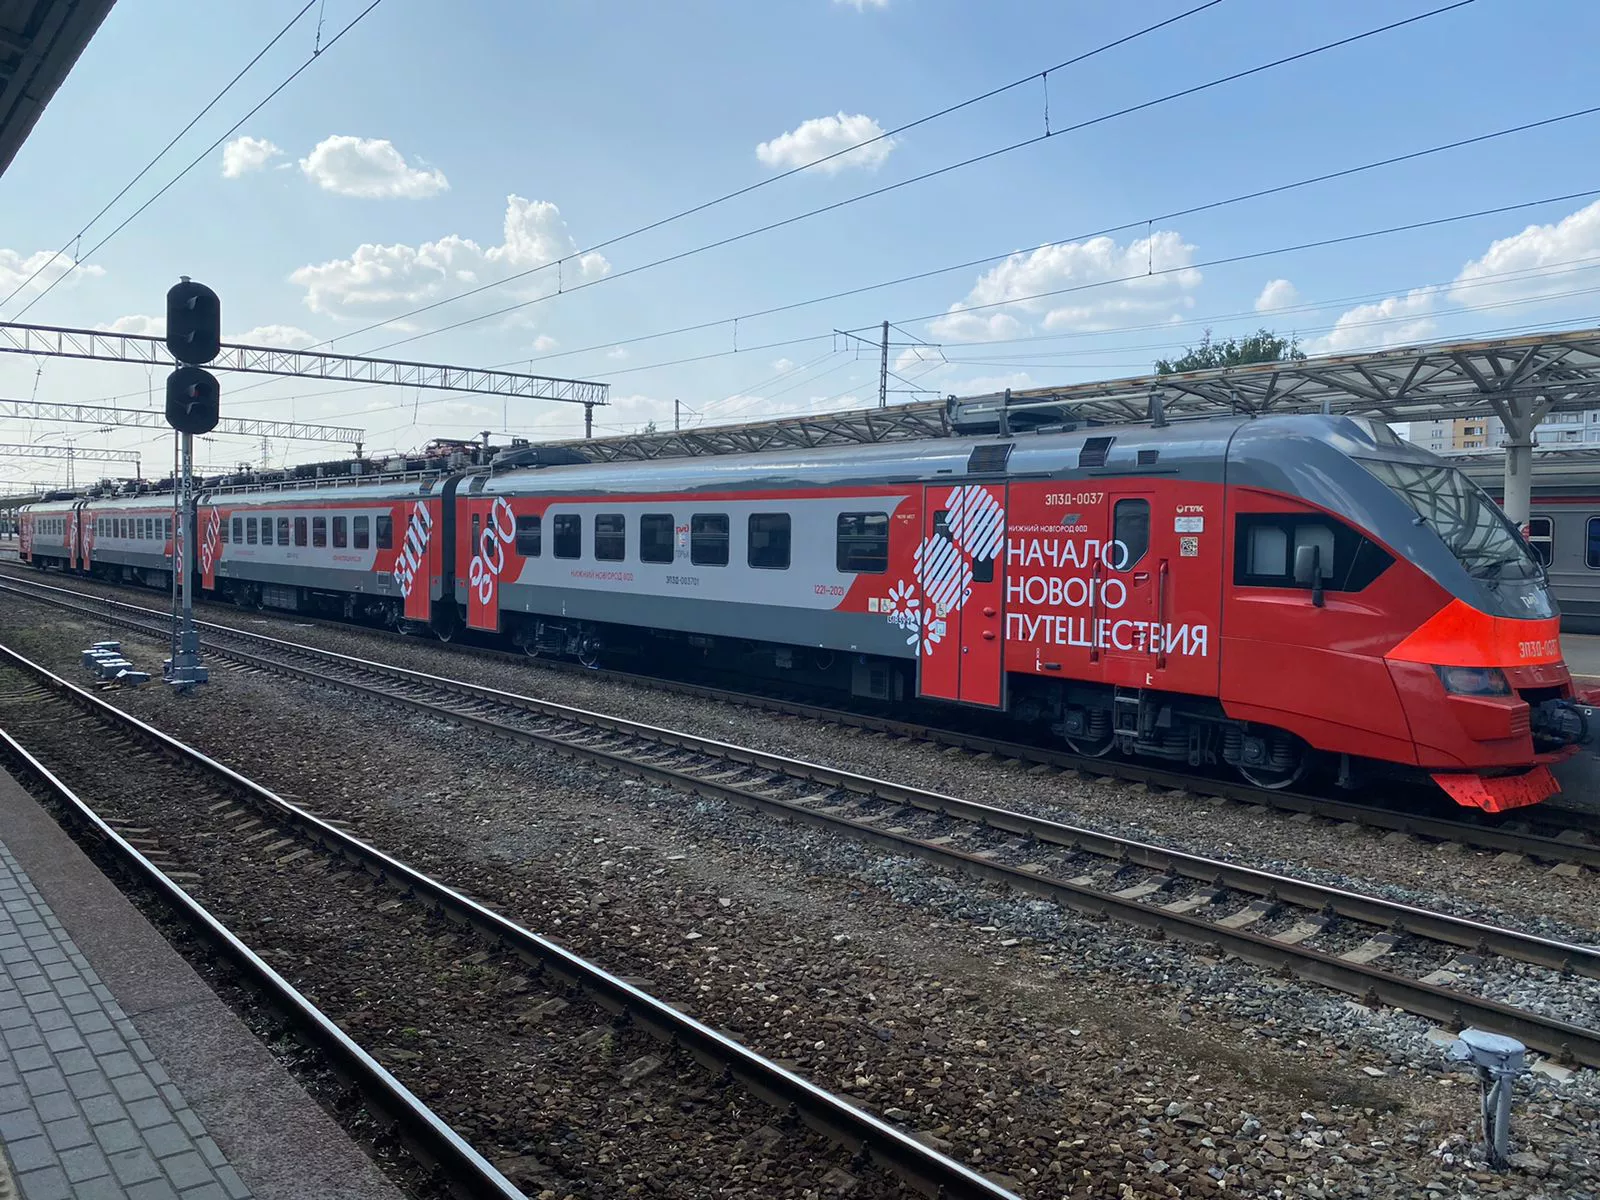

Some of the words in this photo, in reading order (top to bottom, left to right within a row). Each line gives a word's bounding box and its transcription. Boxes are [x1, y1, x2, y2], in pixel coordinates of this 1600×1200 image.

[1008, 524, 1039, 532] НИЖНИЙ
[1040, 525, 1074, 533] НОВГОРОД
[1006, 539, 1129, 573] НАЧАЛО
[1006, 576, 1127, 609] НОВОГО
[1006, 613, 1208, 657] ПУТЕШЕСТВИЯ
